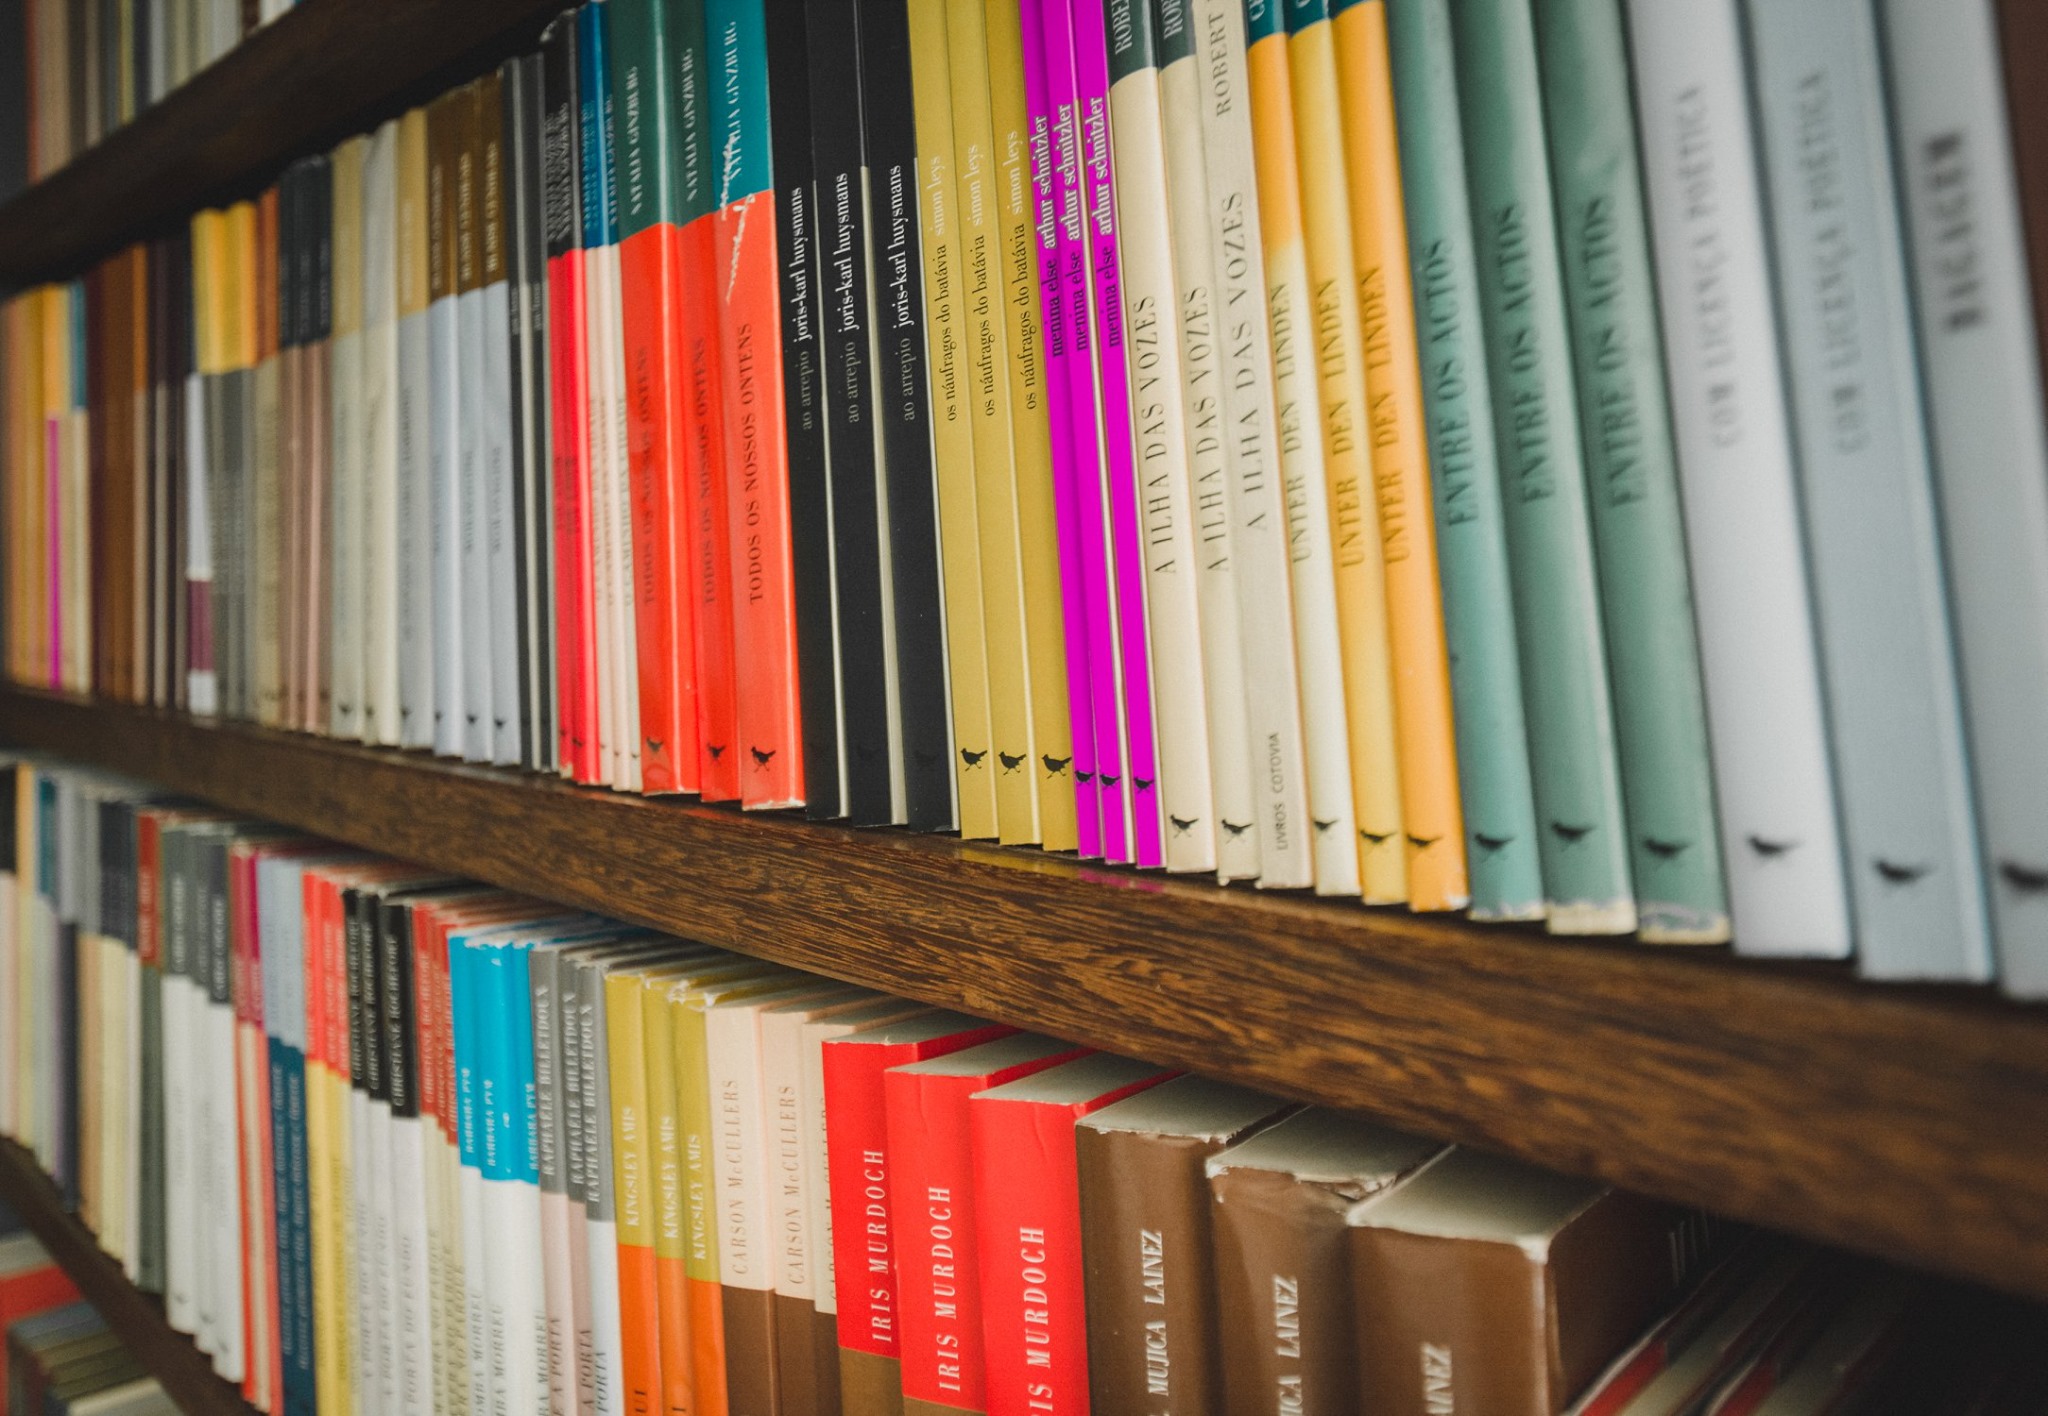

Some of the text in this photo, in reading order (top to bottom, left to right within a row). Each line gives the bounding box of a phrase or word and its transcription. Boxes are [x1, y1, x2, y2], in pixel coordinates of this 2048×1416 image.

[629, 147, 642, 215] NATALIA
[685, 131, 698, 202] NATALIA
[724, 21, 739, 104] GINZBURG
[1208, 12, 1232, 117] ROBERT
[789, 187, 814, 430] ao arrepio joris-karl huysmans
[833, 172, 861, 423] ao arrepio joris-karl huysmans
[888, 165, 916, 421] ao arrepio joris-karl huysmans
[926, 155, 956, 422] os náufragos do batávia simon leys
[964, 144, 995, 417] os náufragos do batávia simon leys
[1003, 131, 1037, 410] os náufragos do batávia simon leys
[1030, 115, 1064, 358] menina else arthur schnitzler
[1052, 104, 1088, 352] menina else arthur schnitzler
[1085, 97, 1120, 348] menina else arthur schnitzler
[738, 323, 763, 605] TODOS OS NOSSOS ONTENS
[1134, 295, 1177, 574] A ILHA DAS VOZES
[1184, 286, 1230, 573] A ILHA DAS VOZES
[1222, 191, 1268, 531] A ILHA DAS VOZES
[1271, 281, 1311, 563] UNTER DEN LINDEN
[1317, 279, 1365, 568] UNTER DEN LINDEN
[1360, 267, 1410, 564] UNTER DEN LINDEN
[1425, 239, 1479, 526] ENTRE OS ACTOS
[1498, 204, 1555, 503] ENTRE OS ACTOS
[1584, 197, 1648, 508] ENTRE OS ACTOS
[1268, 732, 1288, 850] LIVROS COTOVIA
[622, 1106, 640, 1227] KINGSLEY AMIS
[660, 1116, 679, 1239] KINGSLEY AMIS
[687, 1134, 706, 1260] KINGSLEY AMIS
[722, 1080, 748, 1275] CARSON McCULLERS
[778, 1085, 805, 1284] CARSON McCULLERS
[863, 1150, 892, 1343] IRIS MURDOCH
[928, 1186, 961, 1392] IRIS MURDOCH
[1019, 1227, 1052, 1369] MURDOCH
[1141, 1229, 1170, 1397] MUJICA LAINEZ
[1272, 1273, 1300, 1359] LAINEZ
